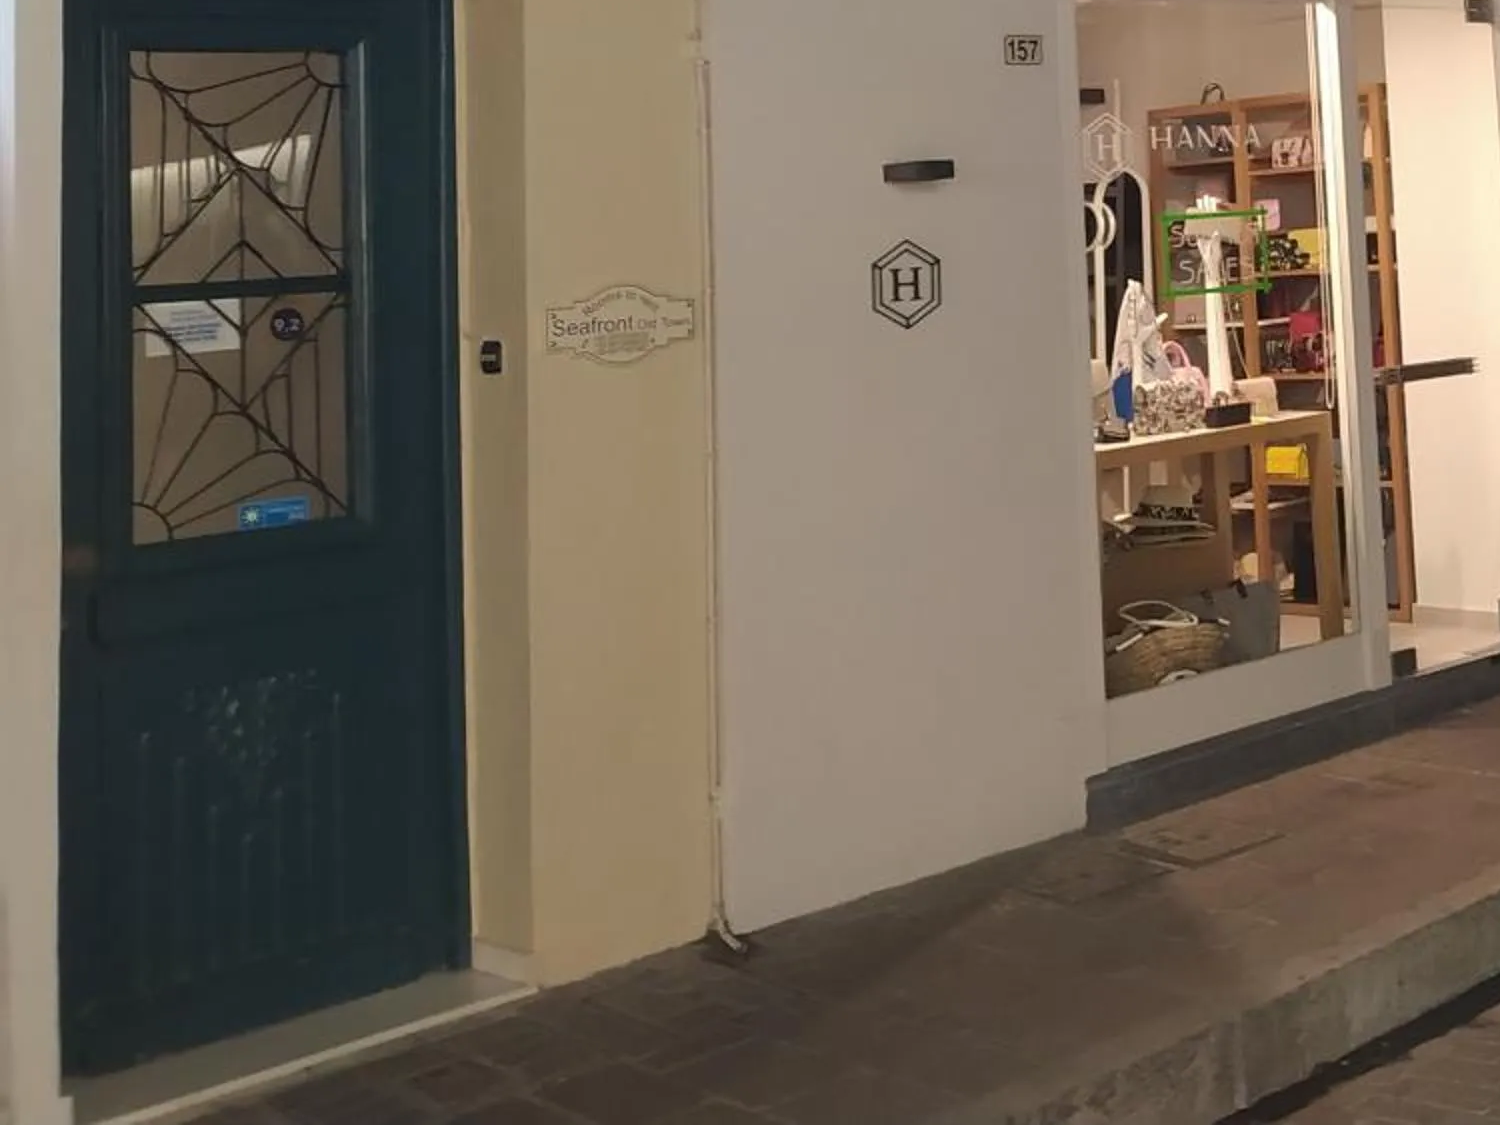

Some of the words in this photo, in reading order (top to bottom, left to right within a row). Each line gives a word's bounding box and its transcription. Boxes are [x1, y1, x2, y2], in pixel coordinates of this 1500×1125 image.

[1007, 38, 1039, 62] 157
[1151, 123, 1261, 151] HANNA
[888, 266, 924, 302] H
[552, 315, 634, 338] Seafront
